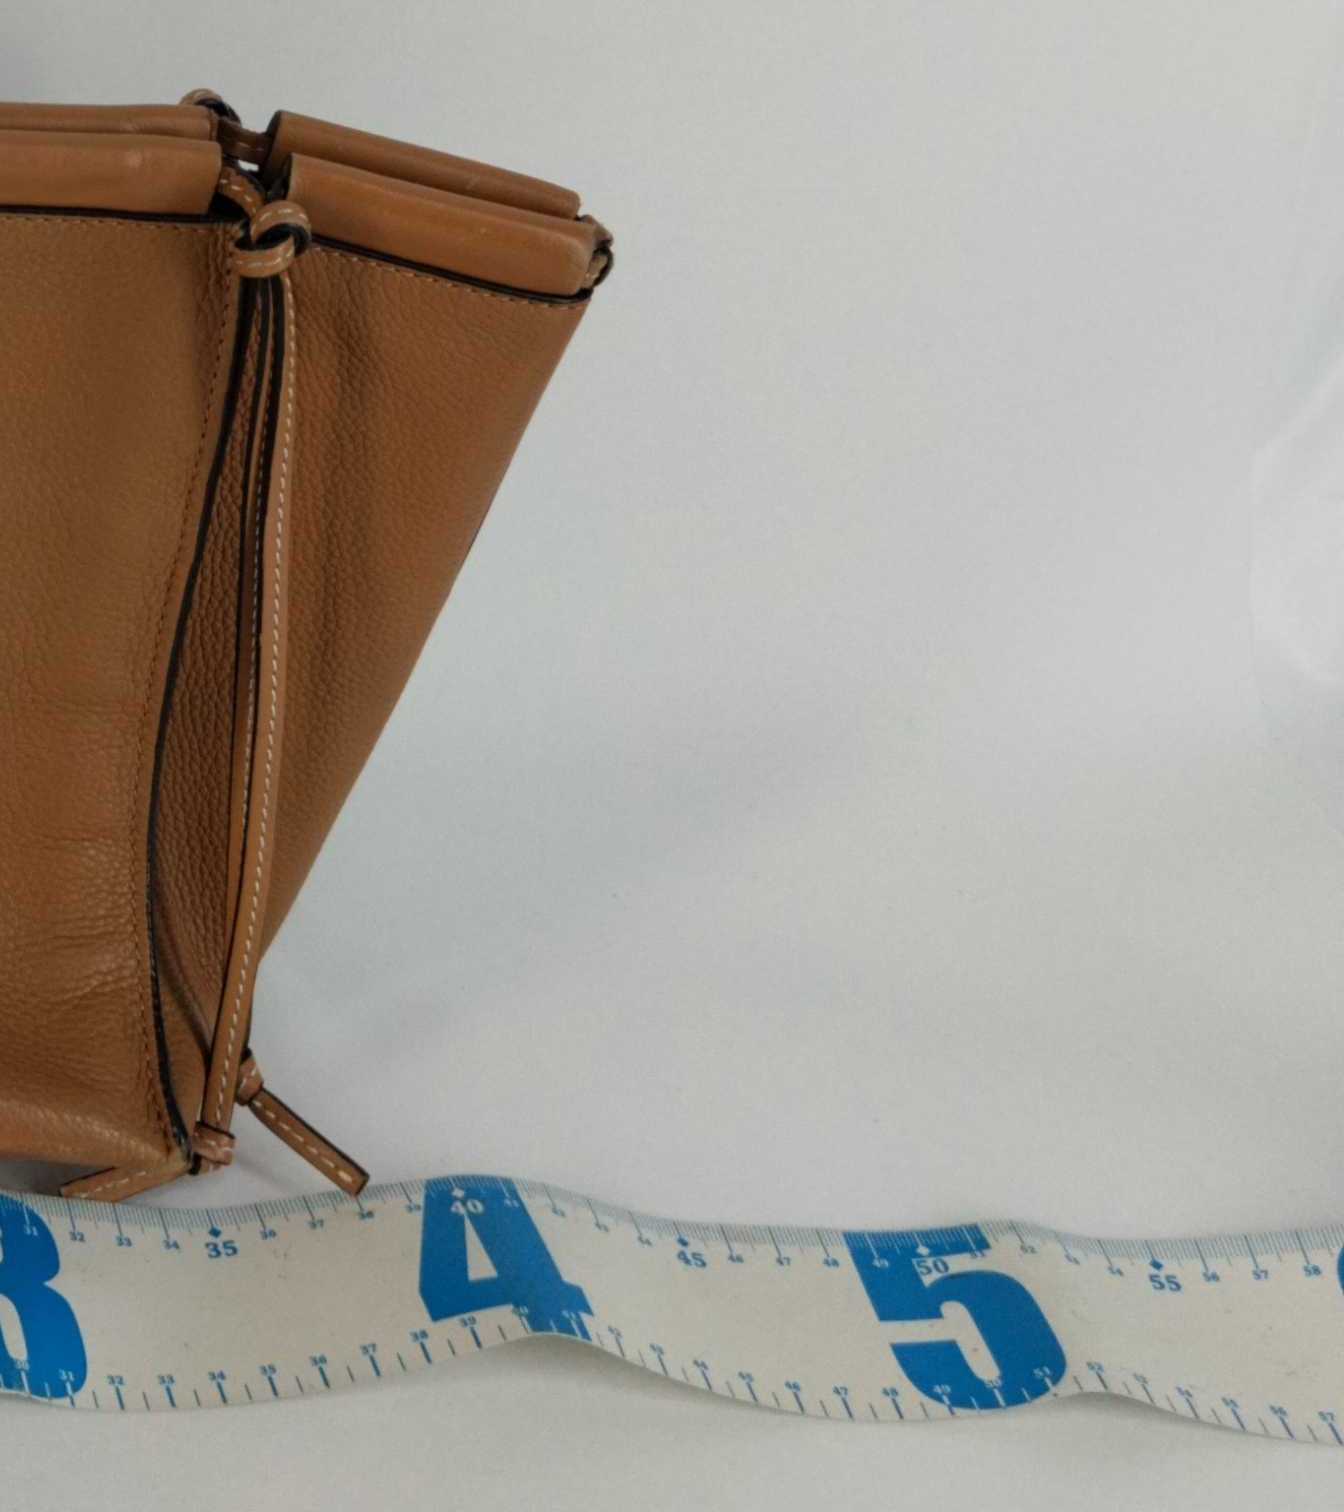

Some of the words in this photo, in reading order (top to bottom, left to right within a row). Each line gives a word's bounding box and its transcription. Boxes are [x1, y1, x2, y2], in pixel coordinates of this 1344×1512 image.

[70, 1232, 85, 1242] 32
[206, 1241, 238, 1258] 35
[451, 1199, 484, 1215] 40
[677, 1250, 706, 1268] 45
[917, 1258, 950, 1276] 50
[1148, 1274, 1181, 1292] 55
[1304, 1267, 1320, 1275] 58
[419, 1175, 593, 1340] 4
[843, 1223, 1067, 1410] 5
[107, 1375, 124, 1385] 32
[158, 1374, 175, 1384] 33
[209, 1372, 225, 1382] 34
